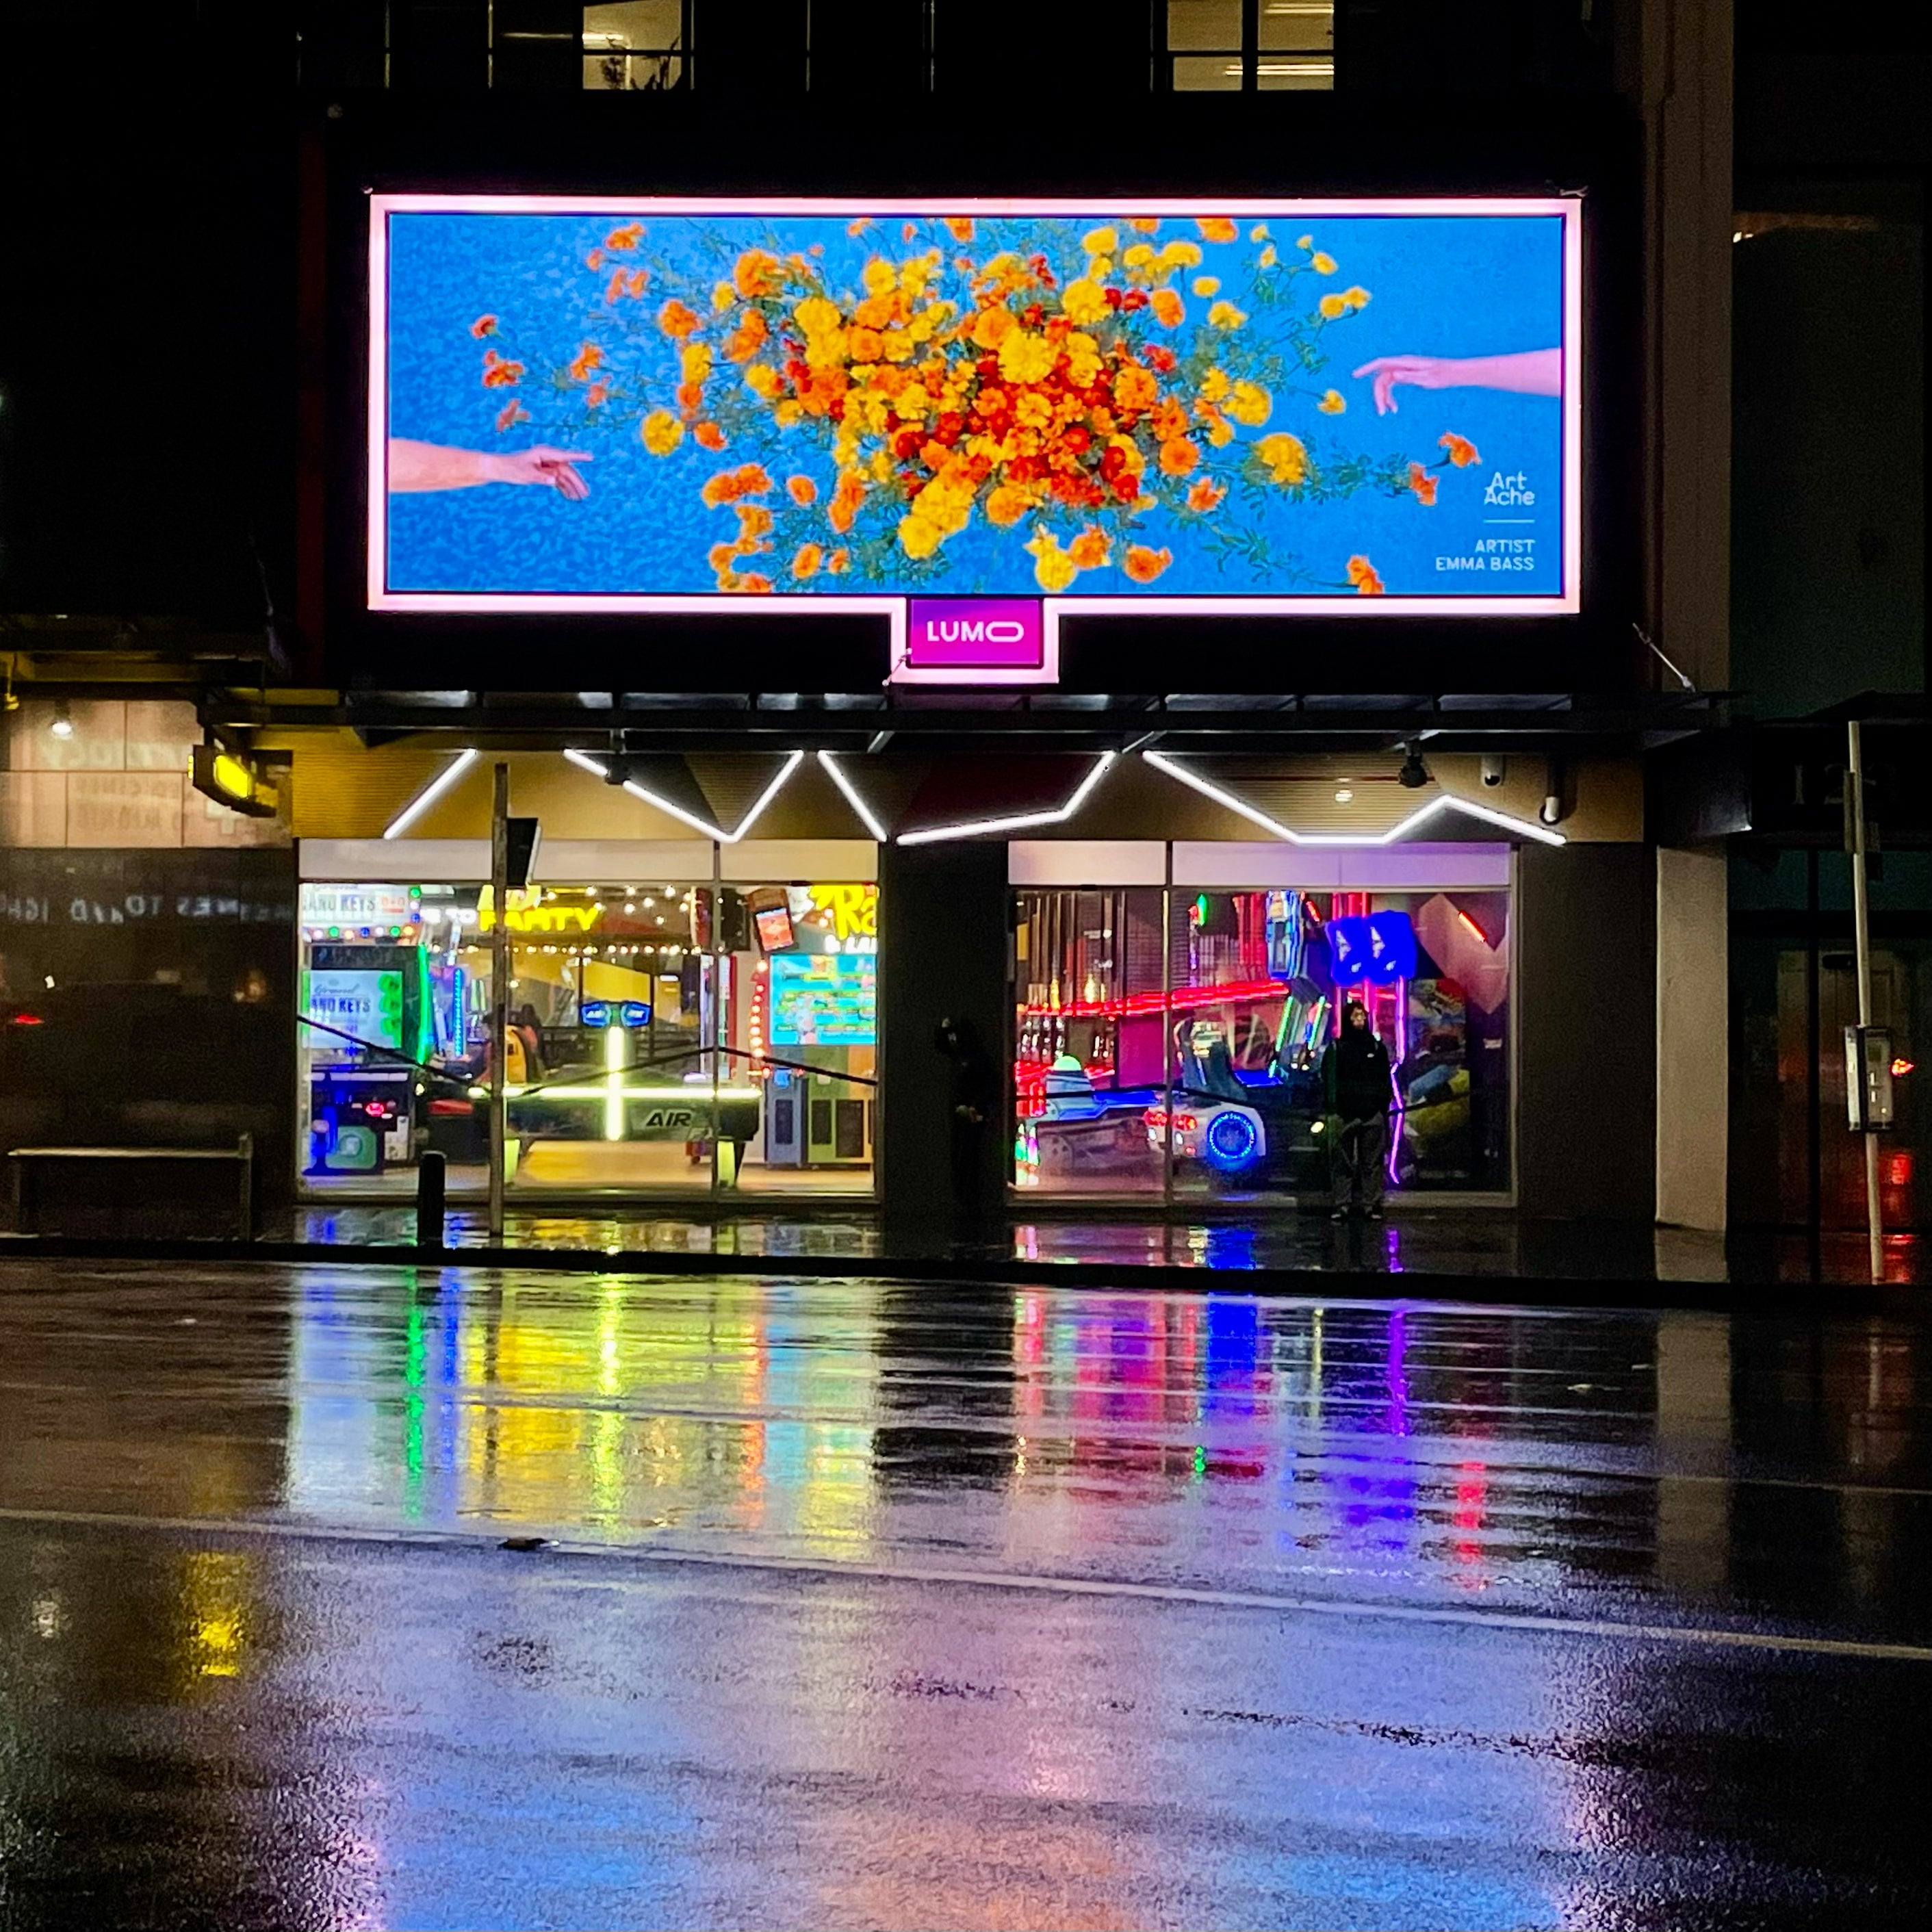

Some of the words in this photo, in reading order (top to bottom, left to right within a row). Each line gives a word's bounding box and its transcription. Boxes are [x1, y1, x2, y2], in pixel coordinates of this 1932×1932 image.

[1491, 470, 1528, 490] Art
[1484, 487, 1535, 506] Ache
[1475, 539, 1536, 554] ARTIST
[1435, 556, 1485, 571] EMMA
[1490, 556, 1534, 571] BASS
[927, 620, 1025, 643] LUMO
[480, 907, 600, 931] PARTY
[645, 1112, 691, 1126] AIR
